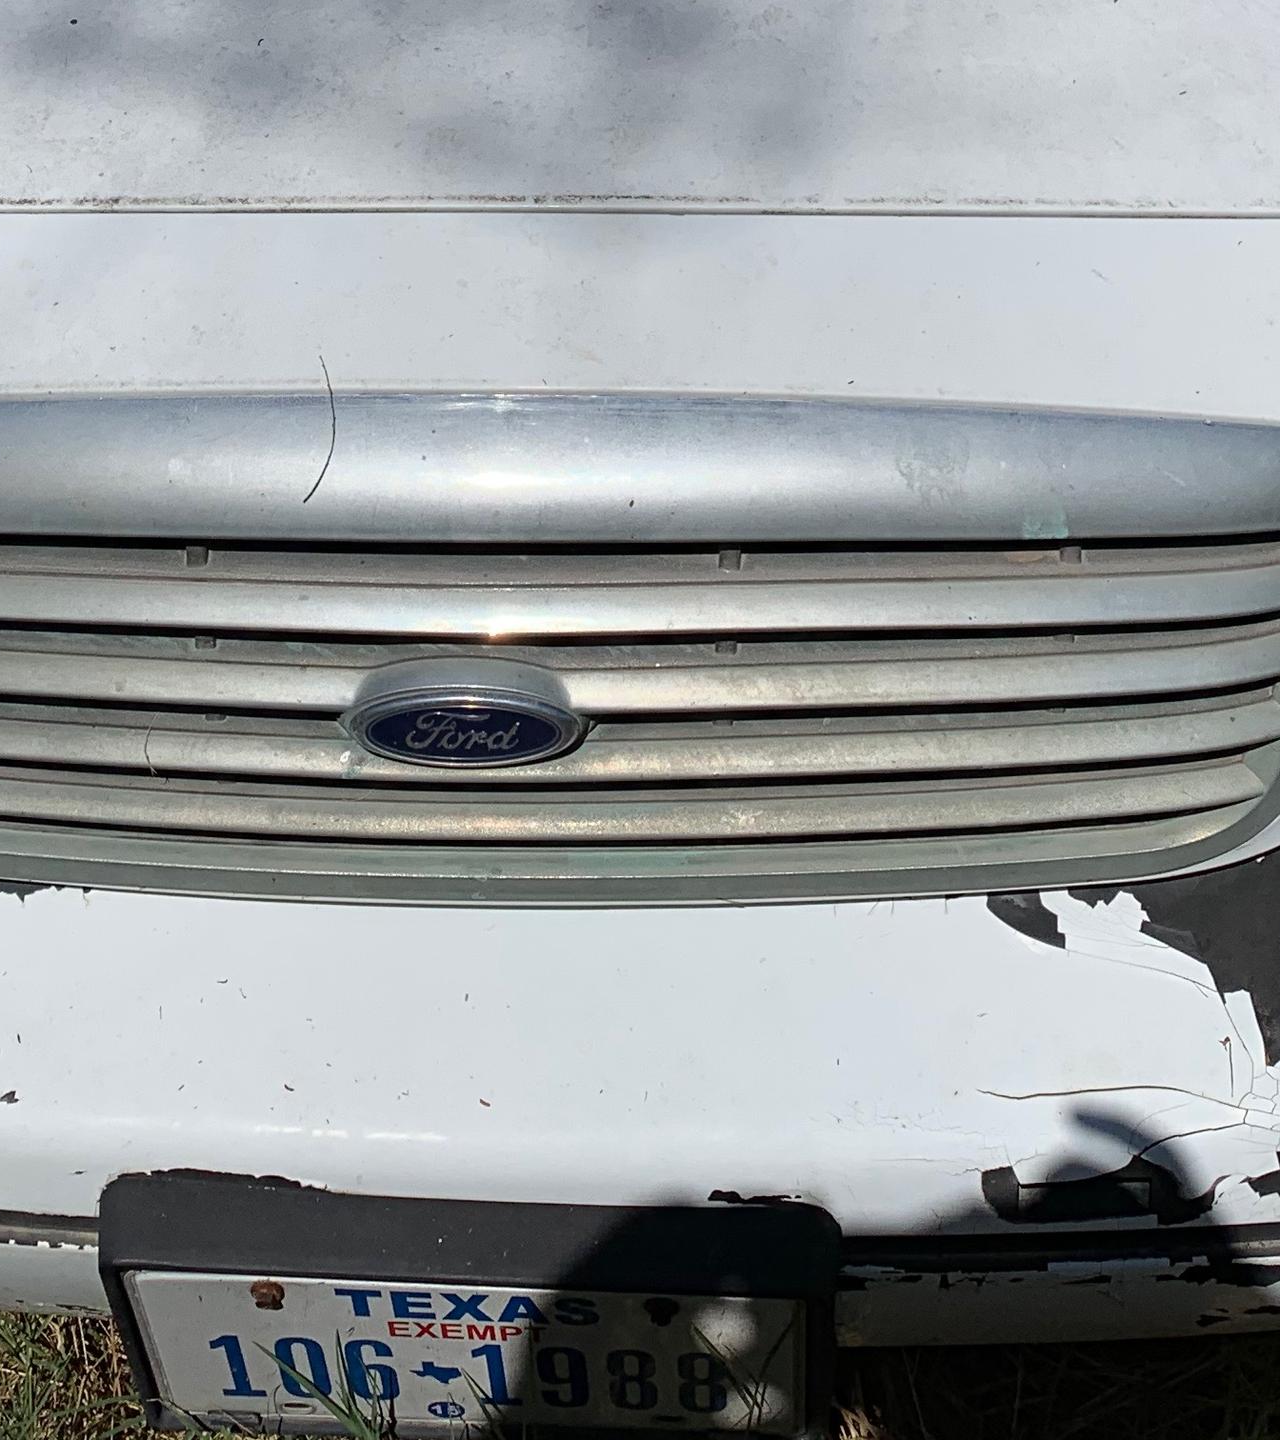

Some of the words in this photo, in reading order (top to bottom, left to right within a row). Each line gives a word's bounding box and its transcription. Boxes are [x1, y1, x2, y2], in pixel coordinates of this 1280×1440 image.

[405, 711, 519, 750] Ford
[334, 1288, 600, 1326] TEXAS
[387, 1320, 547, 1343] EXEMPT
